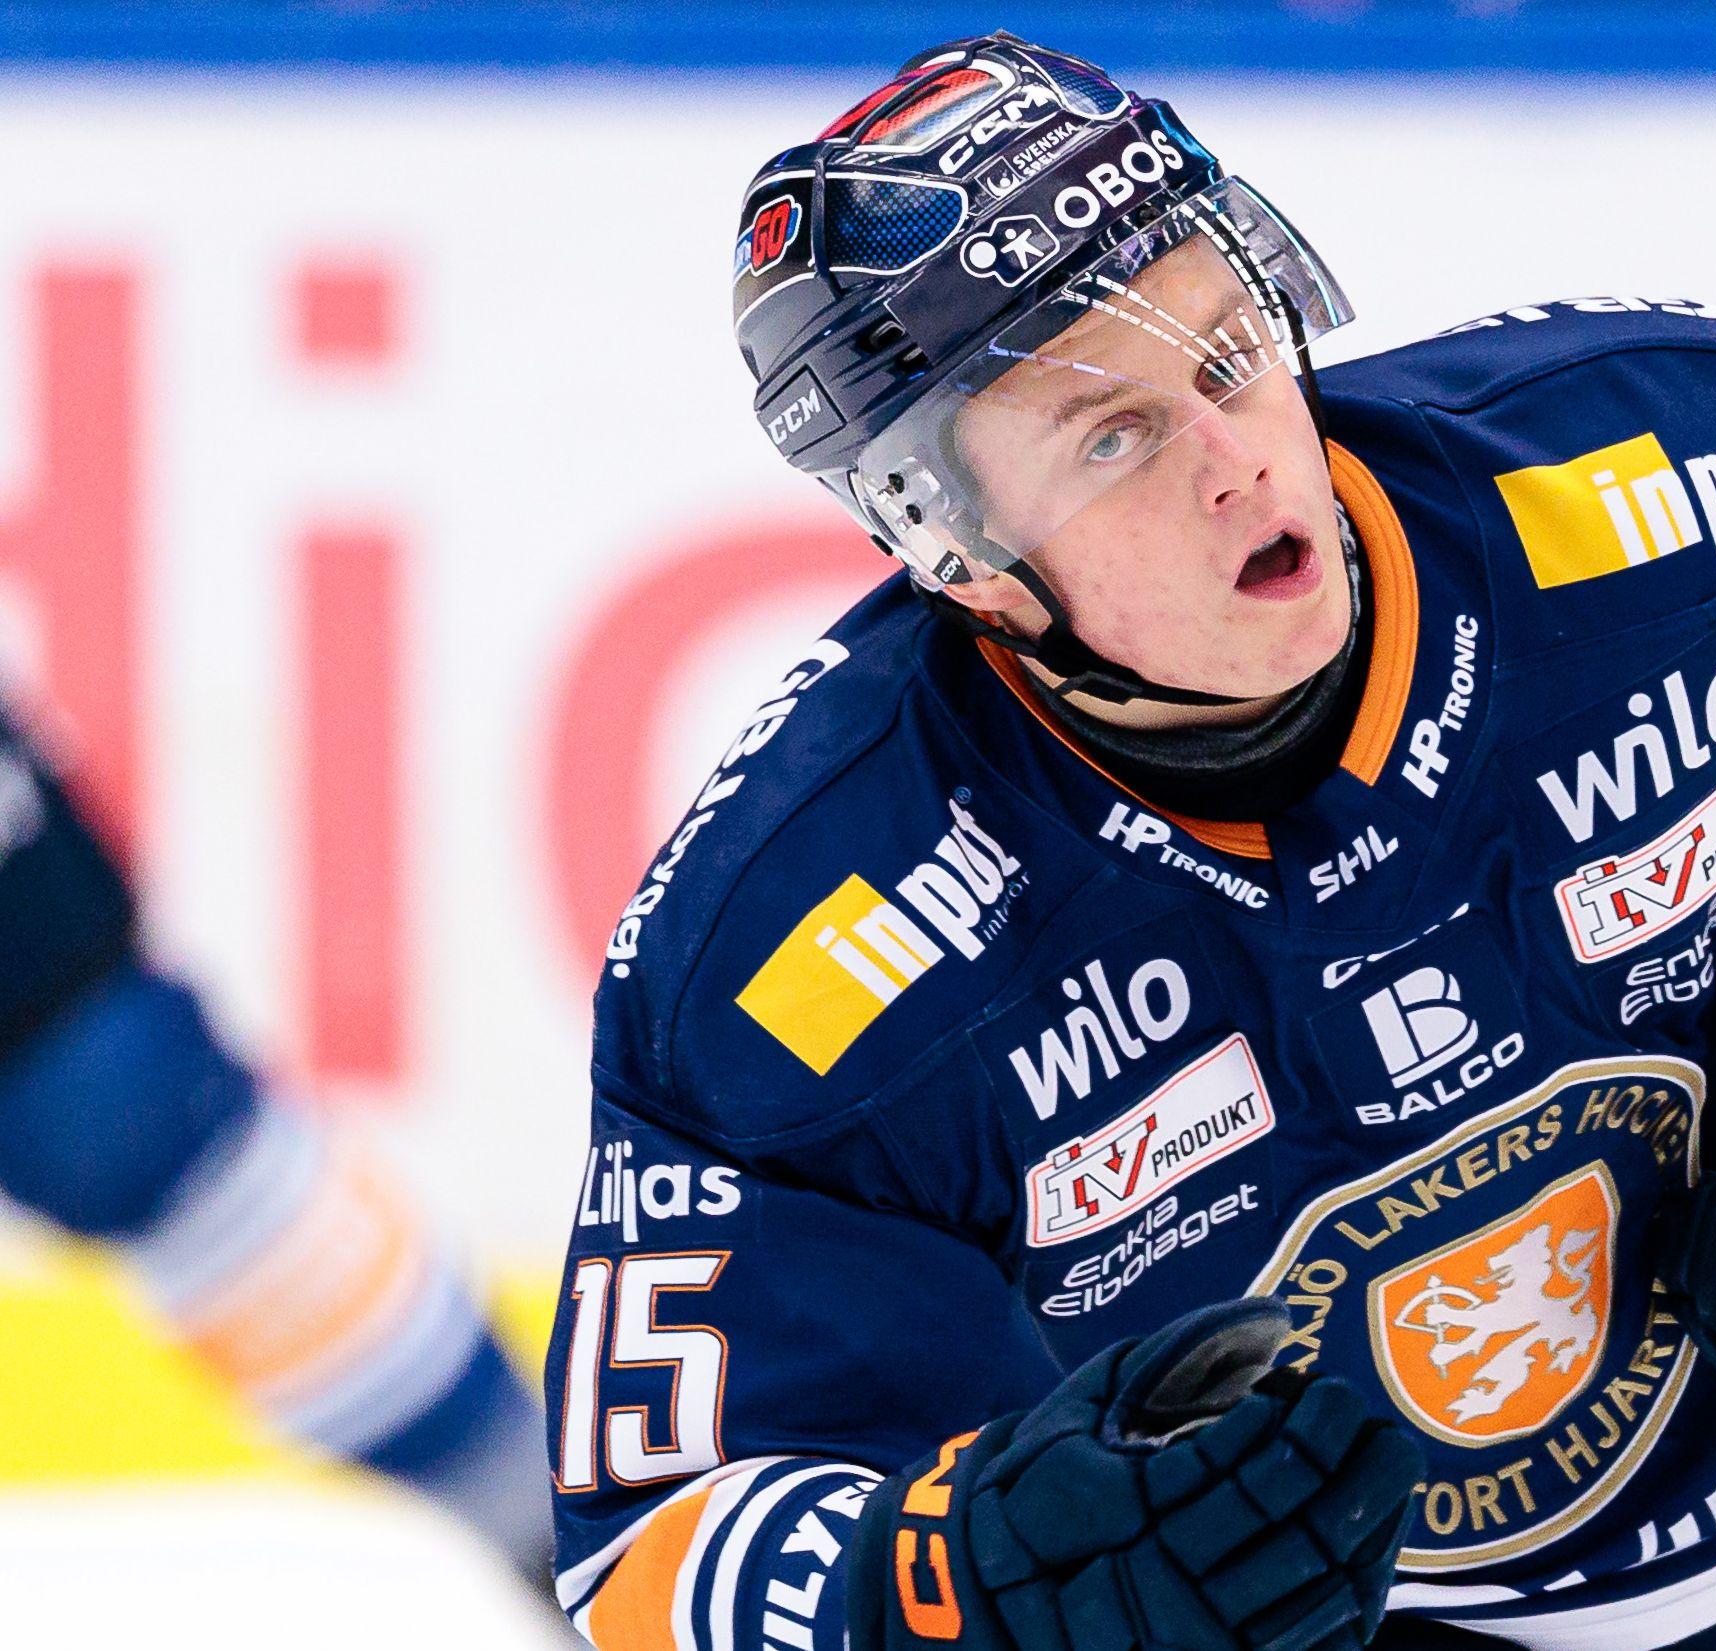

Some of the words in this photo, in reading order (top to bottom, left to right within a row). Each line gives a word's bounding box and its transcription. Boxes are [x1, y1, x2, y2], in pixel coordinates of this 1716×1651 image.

[1013, 121, 1080, 168] SVENSKA
[1054, 130, 1184, 229] OBOS
[767, 388, 822, 445] CCM
[940, 554, 962, 583] CCM
[815, 798, 1022, 1006] input
[1309, 825, 1399, 903] SHL
[1008, 958, 1191, 1121] wilo
[1355, 1032, 1524, 1126] BALCO
[1150, 1091, 1257, 1178] PRODUKT
[1335, 1103, 1563, 1252] LAKERS
[578, 1140, 742, 1243] Liljas
[1040, 1183, 1259, 1317] Elbolaget
[1062, 1195, 1179, 1289] Enkla
[555, 1250, 734, 1494] 15
